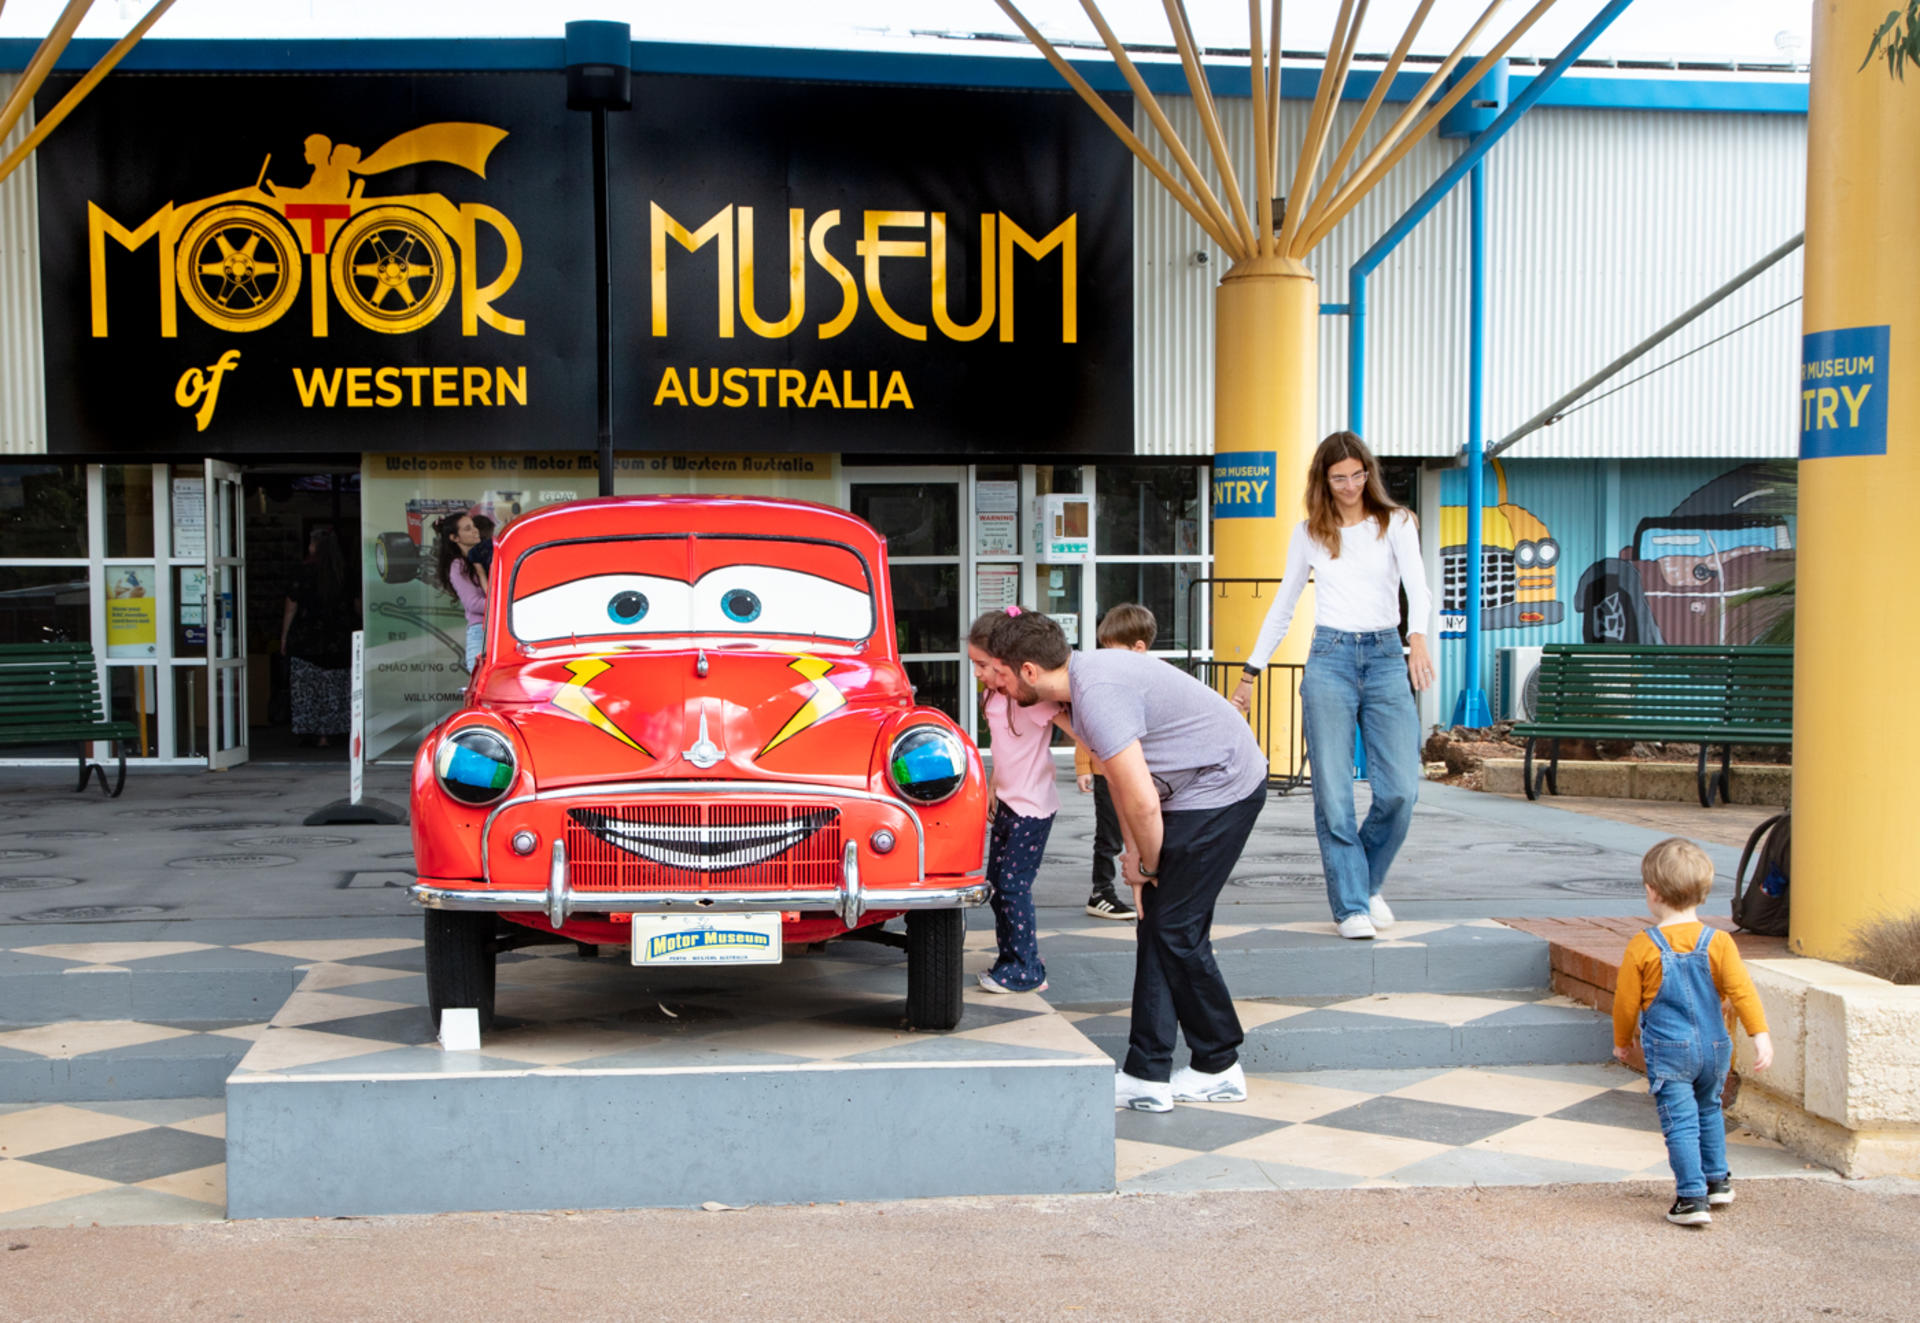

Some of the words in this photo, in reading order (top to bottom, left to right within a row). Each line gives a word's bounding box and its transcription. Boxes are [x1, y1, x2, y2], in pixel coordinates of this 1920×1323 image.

[88, 199, 526, 337] MOTOR
[650, 200, 1078, 344] MUSEUM
[1807, 355, 1874, 380] MUSEUM
[174, 349, 241, 432] of
[292, 366, 528, 408] WESTERN
[653, 366, 915, 410] AUSTRALIA
[386, 455, 464, 471] Welcome
[469, 456, 486, 470] to
[490, 456, 519, 471] the
[523, 456, 574, 471] Motor
[577, 456, 645, 471] Mueum
[651, 457, 667, 471] of
[672, 456, 737, 471] Western
[742, 457, 814, 472] Australia
[1228, 466, 1269, 477] MUSEUM
[653, 933, 699, 956] Motor
[704, 931, 767, 945] Museum
